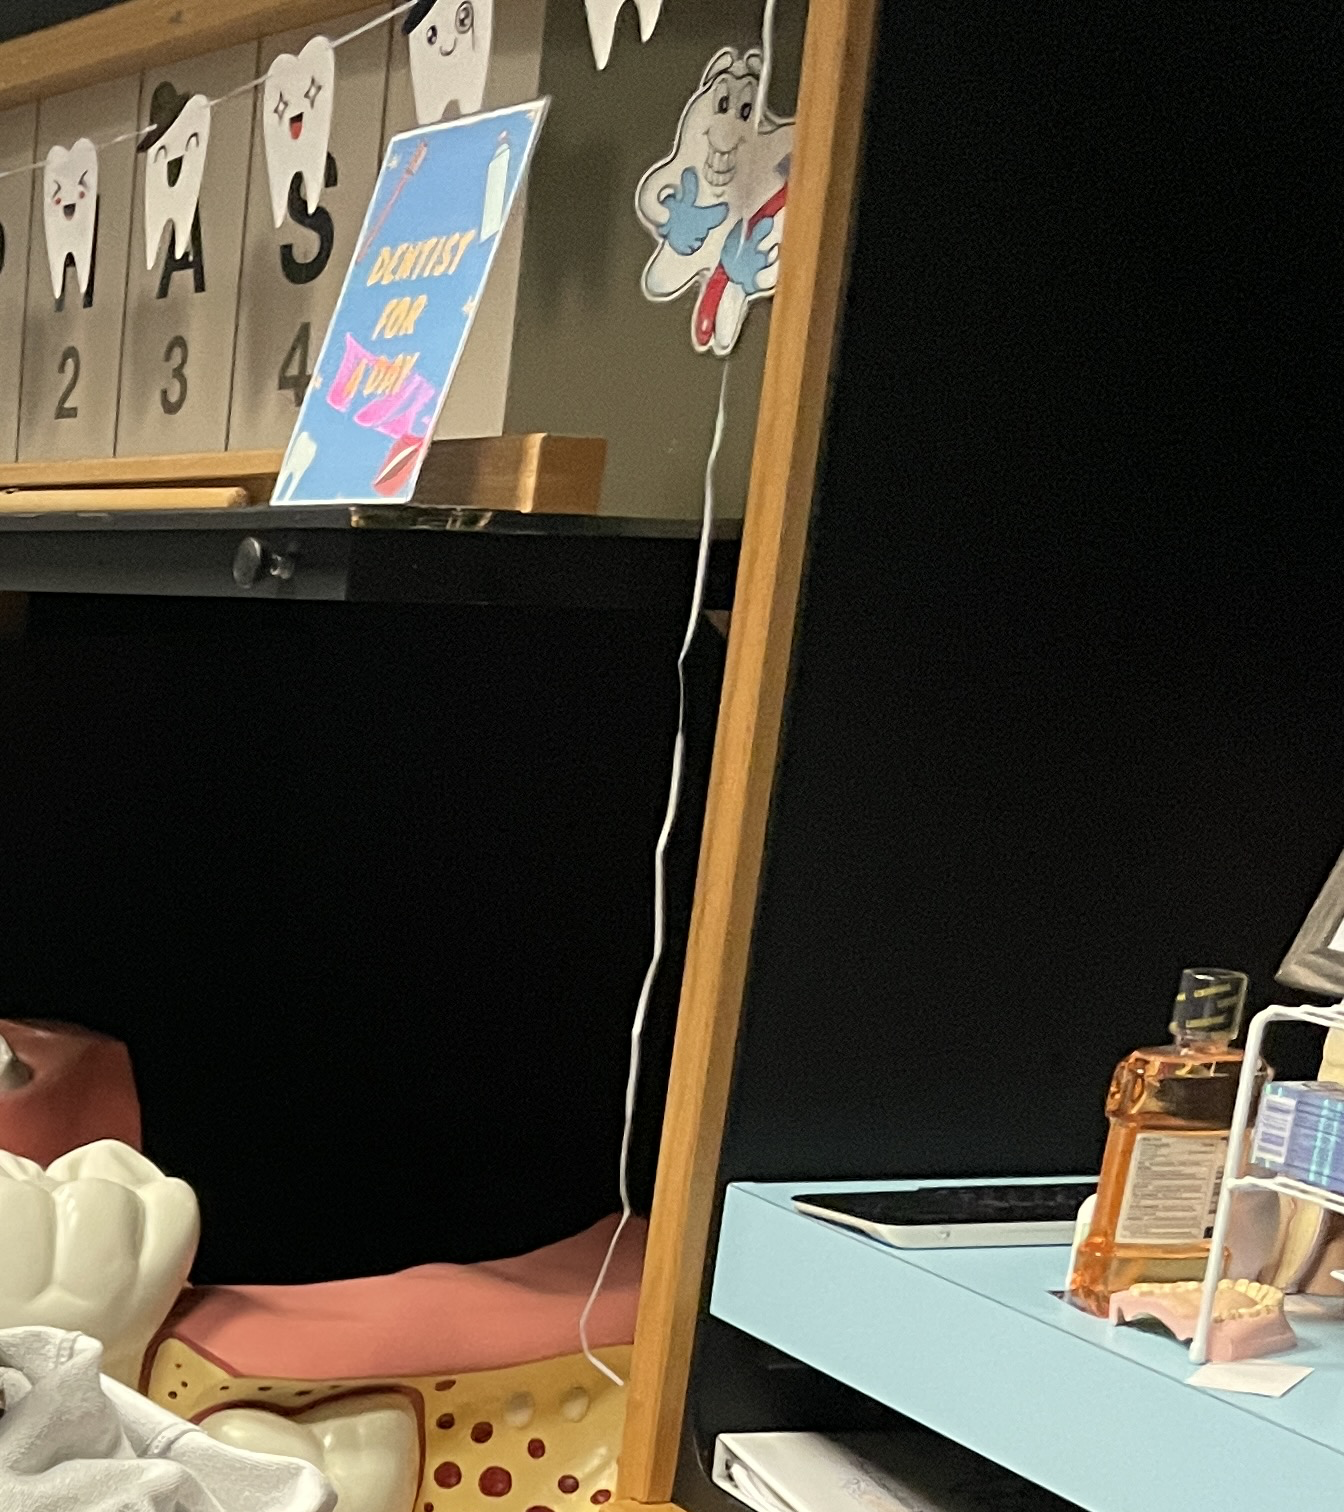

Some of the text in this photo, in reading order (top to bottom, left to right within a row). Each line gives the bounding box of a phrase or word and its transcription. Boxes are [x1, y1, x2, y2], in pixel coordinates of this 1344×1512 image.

[366, 229, 476, 287] DENTIST
[372, 294, 428, 341] FOR
[54, 345, 81, 420] 2
[160, 335, 189, 416] 3
[278, 321, 312, 407] 4
